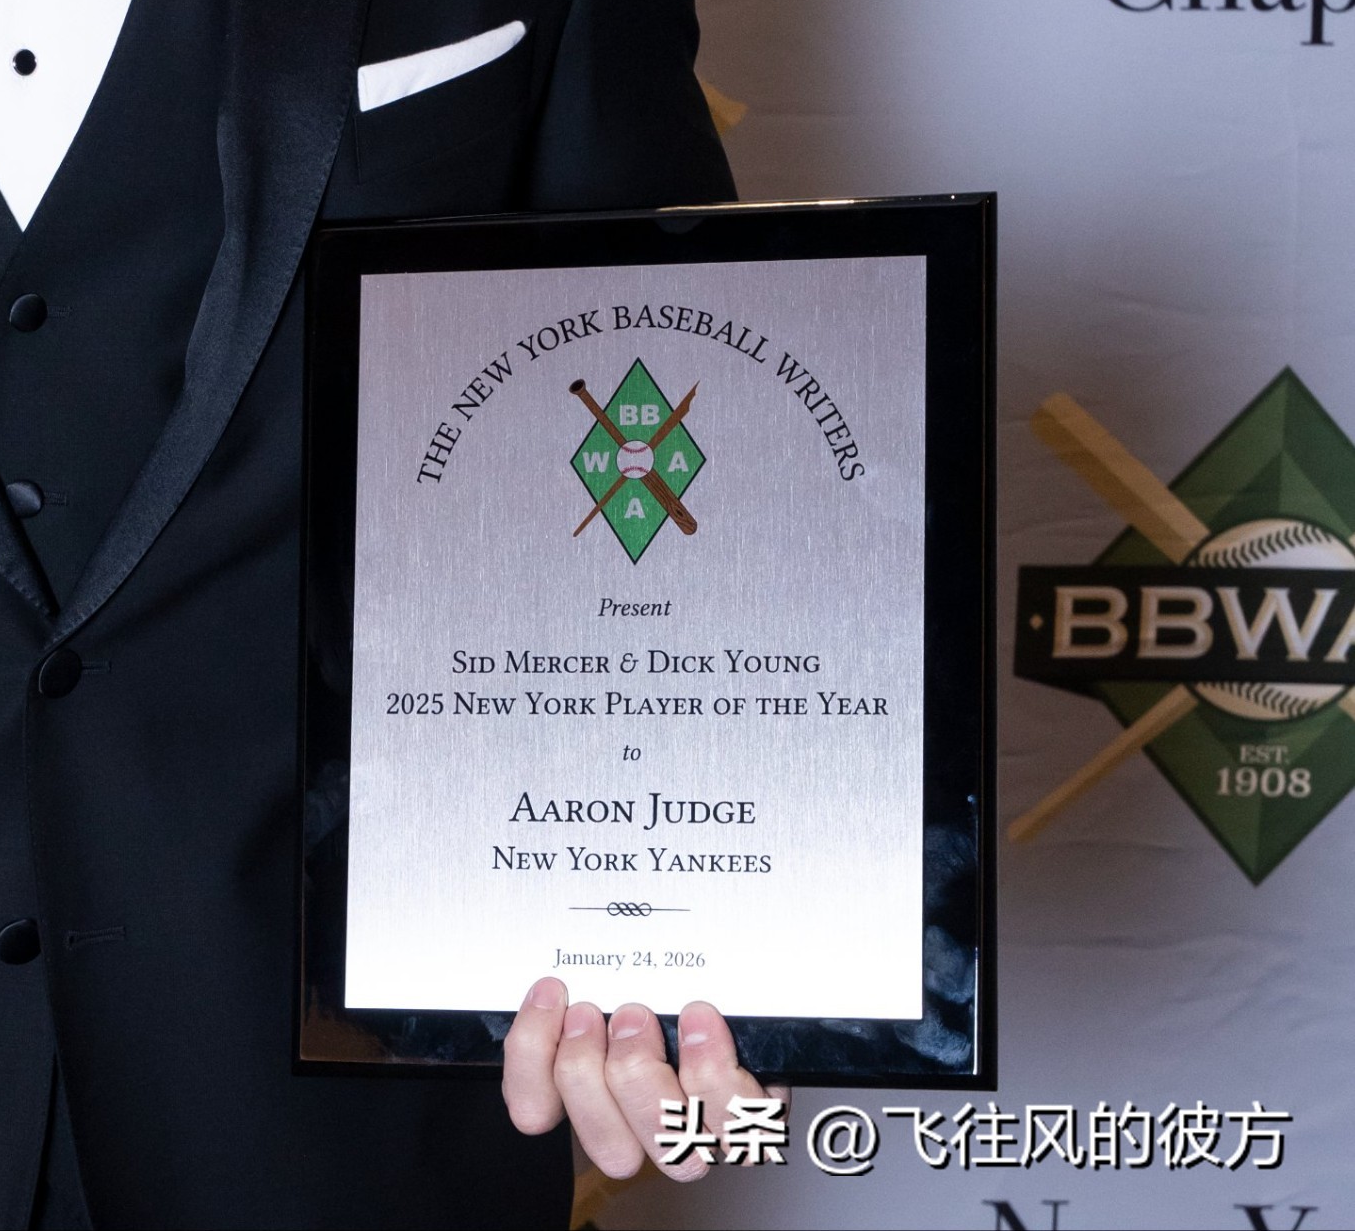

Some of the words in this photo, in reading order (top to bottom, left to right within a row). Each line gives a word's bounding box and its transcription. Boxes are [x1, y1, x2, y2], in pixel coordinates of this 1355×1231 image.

[416, 422, 463, 485] THE
[452, 352, 515, 423] NEW
[516, 310, 604, 363] YORK
[612, 304, 768, 363] BASEBALL
[775, 352, 866, 483] WRITERS
[598, 598, 672, 617] Present
[619, 652, 639, 674] &
[386, 692, 445, 715] 2025
[622, 743, 642, 761] to
[1239, 744, 1291, 765] EST.
[1216, 767, 1312, 798] 1908
[553, 949, 625, 970] January
[633, 951, 657, 968] 24,
[664, 951, 706, 968] 2026
